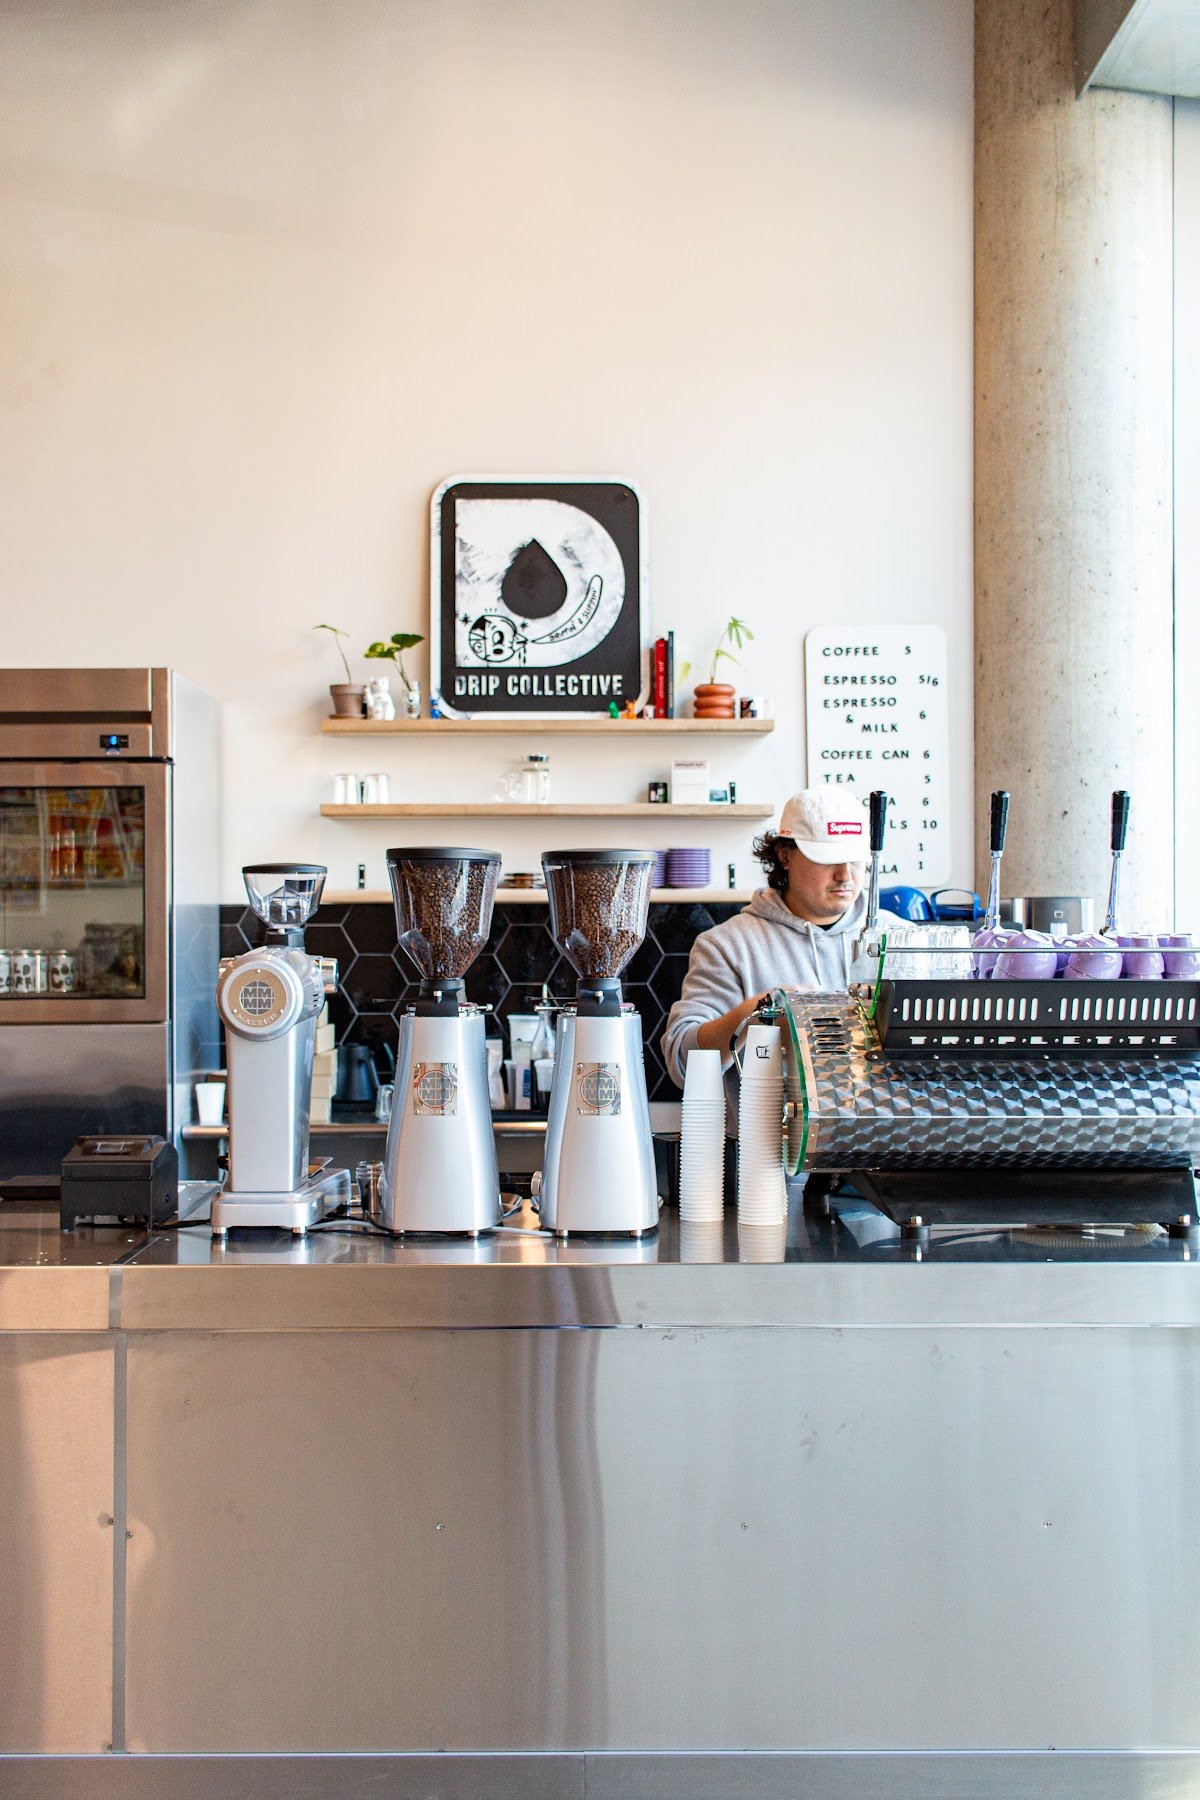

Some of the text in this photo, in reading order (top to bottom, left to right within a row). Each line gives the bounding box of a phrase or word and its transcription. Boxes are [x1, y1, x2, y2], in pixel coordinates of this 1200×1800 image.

[822, 645, 912, 657] COFFEE 5
[454, 674, 623, 696] DRIP COLLECTIVE
[824, 675, 897, 685] ESPRESSO
[824, 697, 897, 709] ESPRESSO
[845, 714, 854, 724] &
[919, 710, 926, 720] 6
[861, 723, 898, 733] MILK
[821, 750, 930, 760] COFFEE CAN 6
[823, 773, 931, 784] TEA 5
[922, 797, 930, 807] 6
[829, 823, 861, 834] Supreme
[922, 820, 938, 829] 10
[917, 843, 924, 852] 1
[917, 861, 924, 870] 1
